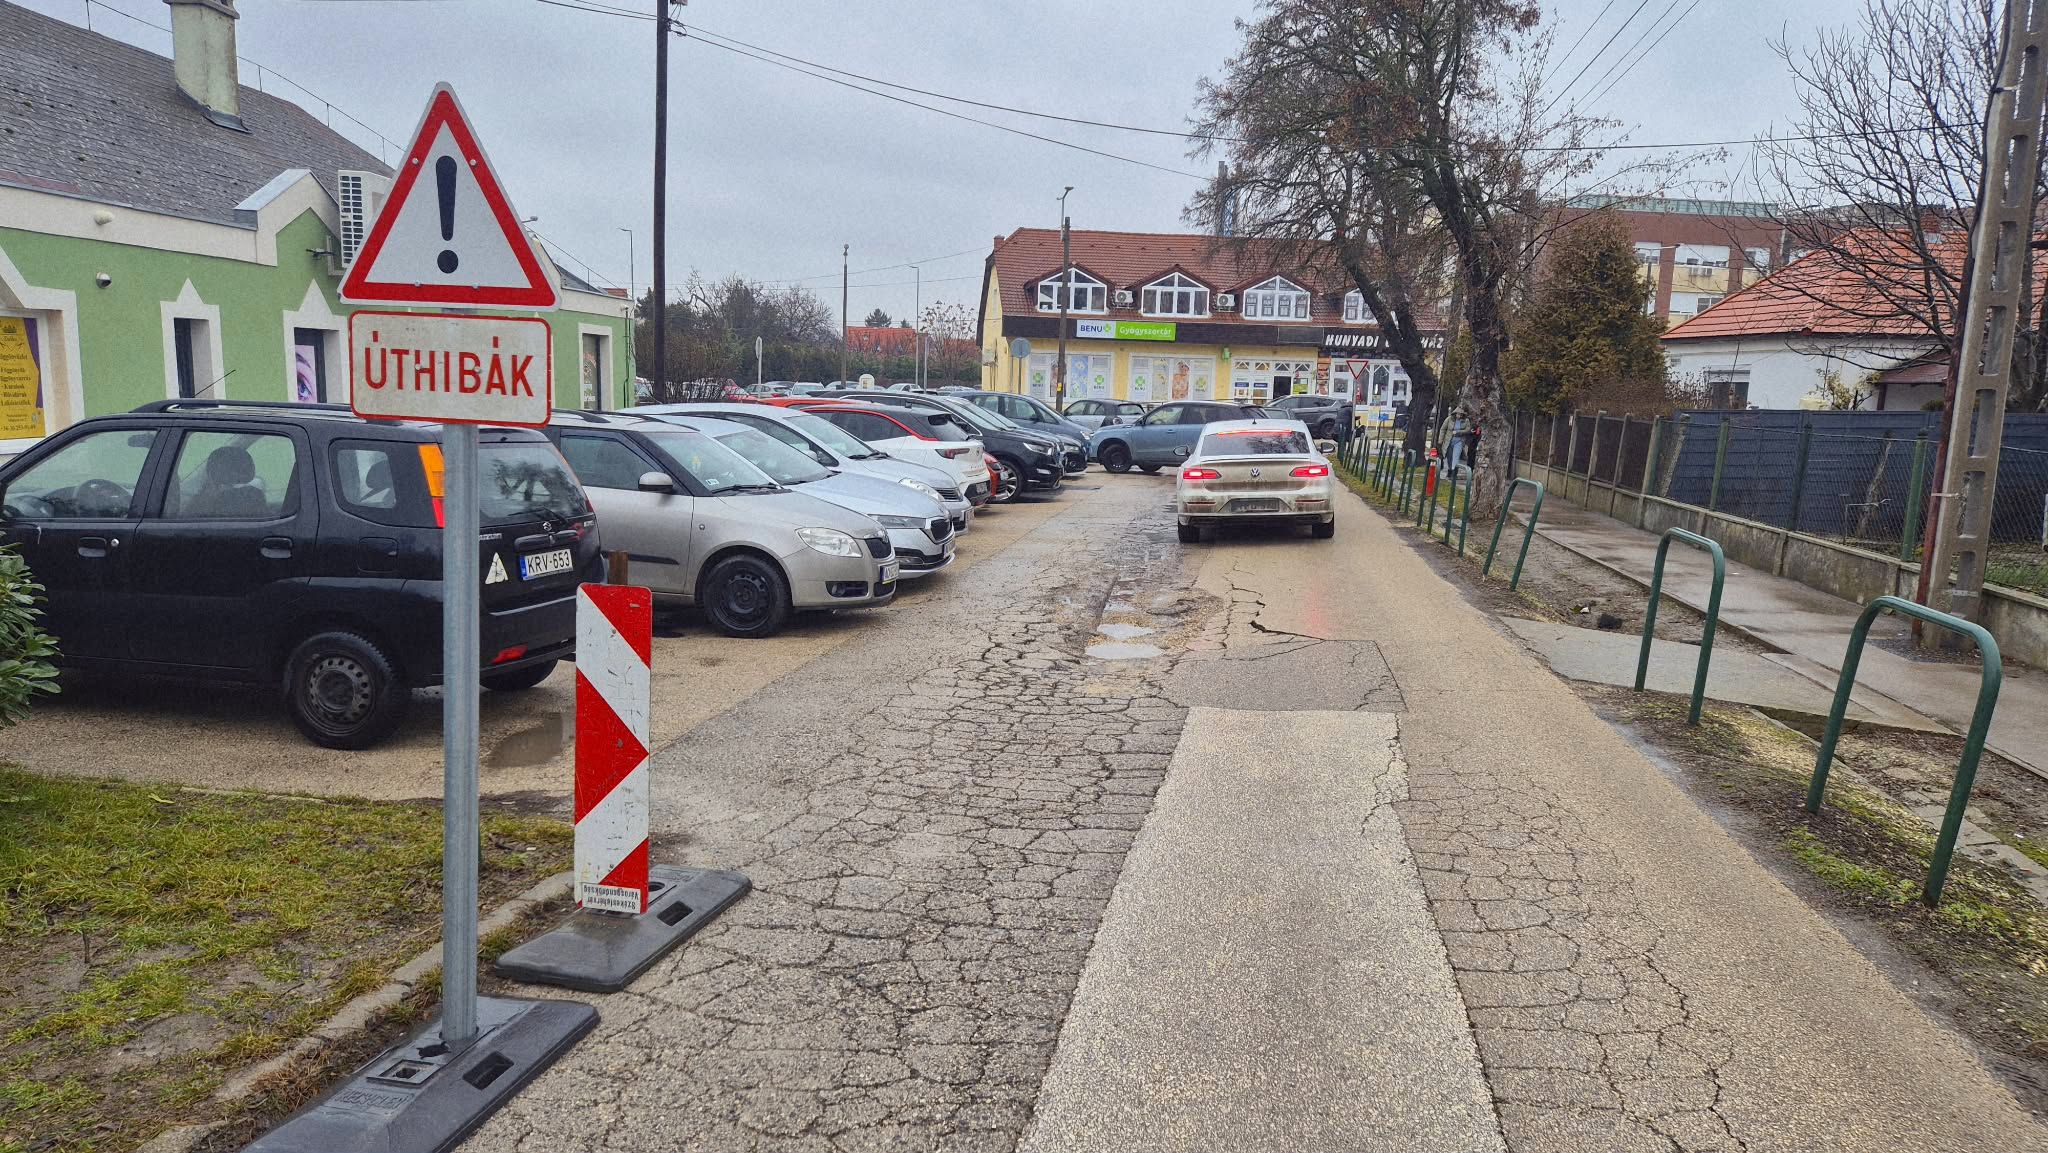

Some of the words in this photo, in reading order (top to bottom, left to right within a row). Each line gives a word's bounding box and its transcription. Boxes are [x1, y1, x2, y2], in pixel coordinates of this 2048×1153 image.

[1080, 324, 1103, 333] BENU
[1325, 334, 1379, 348] HUNYADI
[364, 330, 534, 397] ÚTHIBÁK
[527, 551, 571, 575] KRV-653
